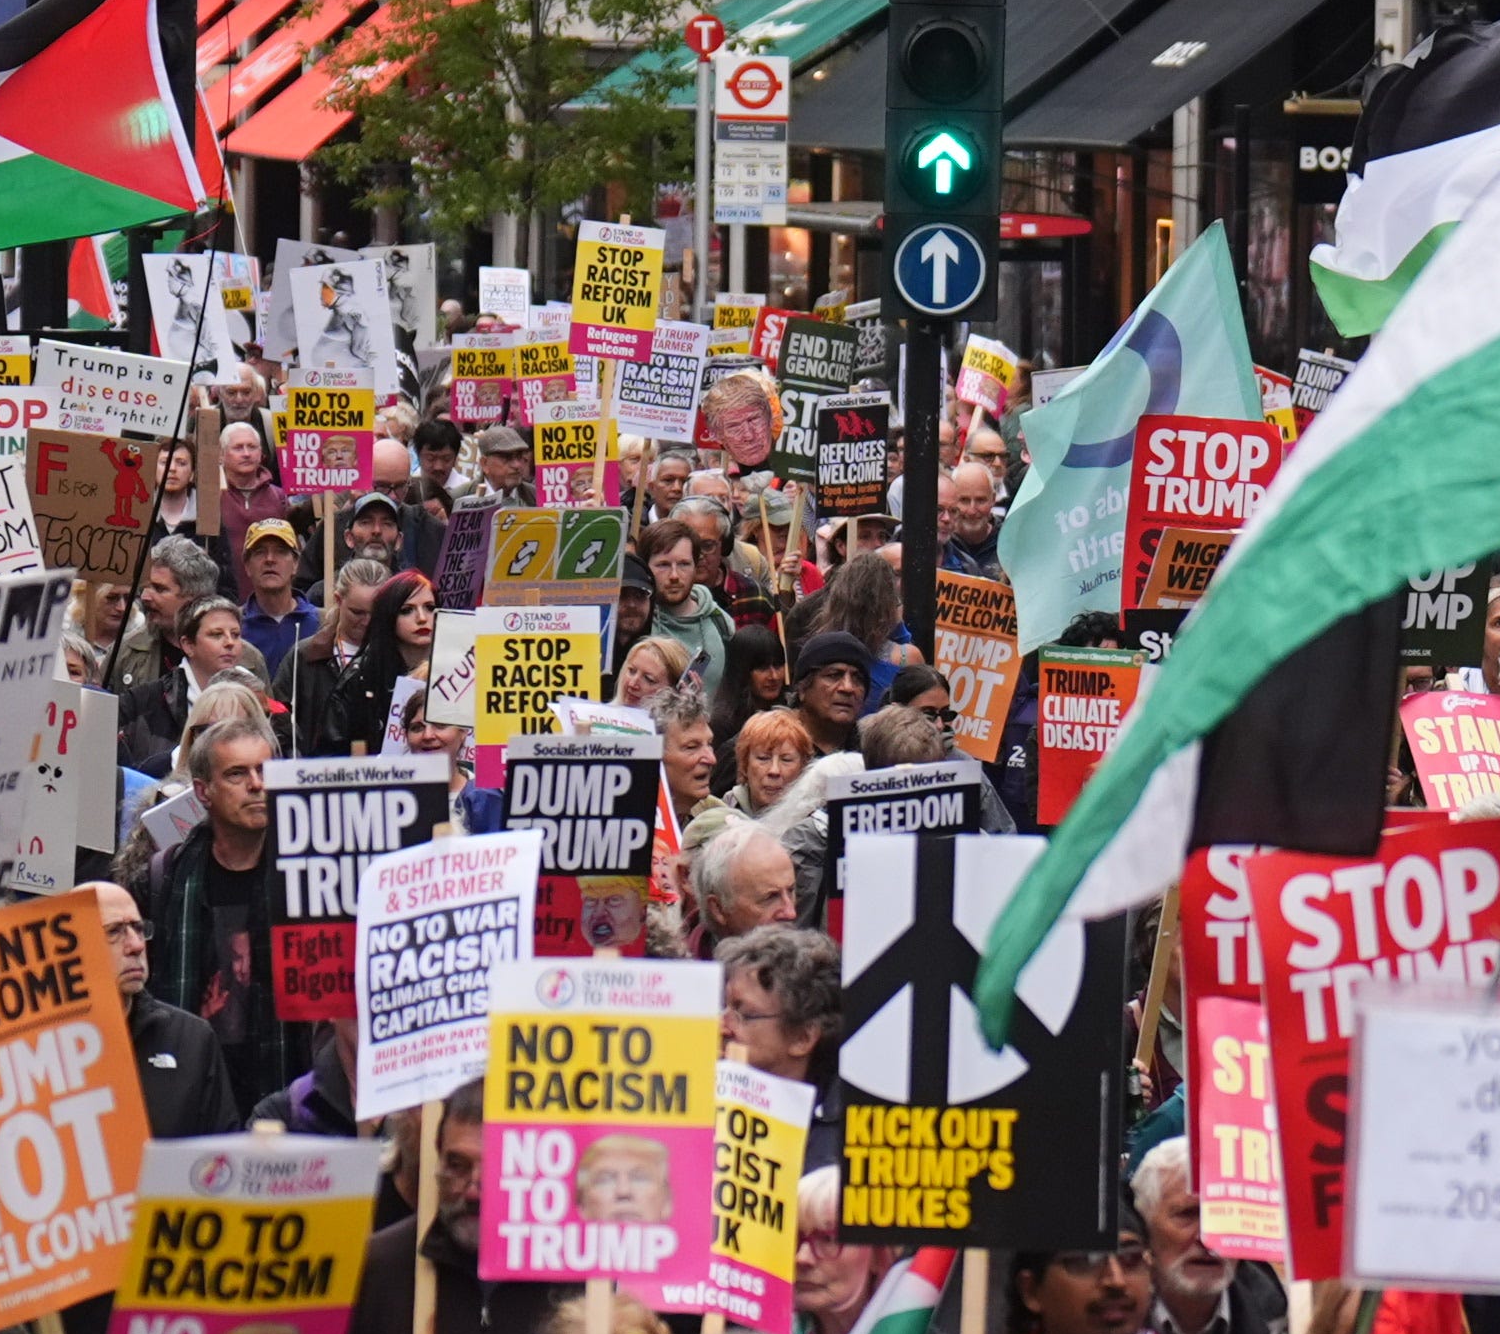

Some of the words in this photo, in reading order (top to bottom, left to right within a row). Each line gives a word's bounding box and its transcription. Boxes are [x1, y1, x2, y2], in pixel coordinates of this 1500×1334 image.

[737, 81, 750, 89] BUS
[752, 81, 770, 89] STOP
[597, 246, 644, 267] STOP
[586, 265, 650, 287] RACIST
[580, 284, 652, 308] REFORM
[602, 305, 626, 325] UK
[587, 326, 638, 345] Refugees
[587, 341, 634, 357] welcome
[787, 333, 825, 358] END
[830, 341, 853, 364] THE
[54, 349, 127, 380] Trump
[138, 364, 153, 383] is
[163, 374, 173, 385] a
[786, 355, 850, 382] GENOCIDE
[61, 376, 163, 410] disease.
[105, 405, 140, 426] fight
[148, 413, 168, 427] it!
[36, 442, 69, 496] F
[58, 480, 70, 494] IS
[72, 481, 98, 498] FOR
[845, 1106, 934, 1148] KICK
[939, 1108, 1018, 1149] OUT
[1467, 1135, 1493, 1168] 4
[844, 1147, 1016, 1190] TRUMP'S
[845, 1187, 972, 1228] NUKES
